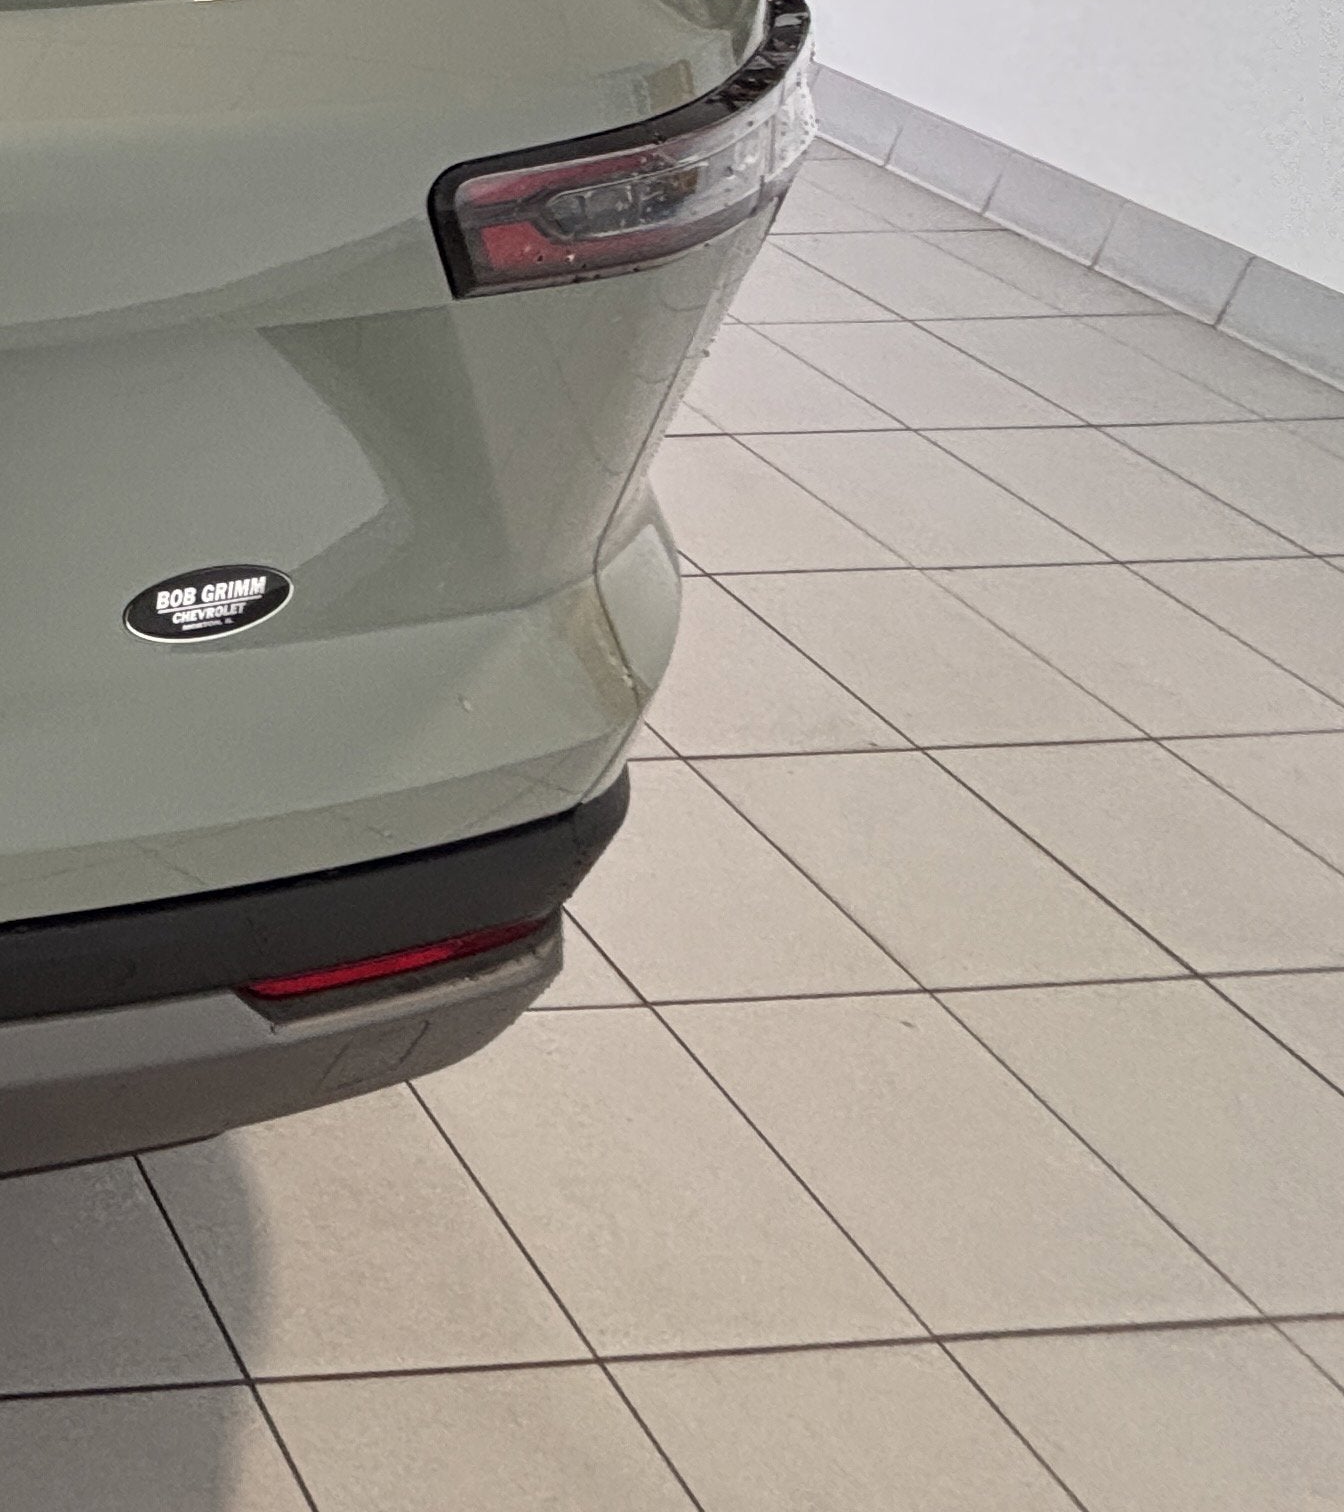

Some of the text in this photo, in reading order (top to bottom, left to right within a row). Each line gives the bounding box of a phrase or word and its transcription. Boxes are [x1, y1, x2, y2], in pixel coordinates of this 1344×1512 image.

[156, 576, 267, 610] BOB GRIMM
[172, 602, 247, 625] CHEVROLET
